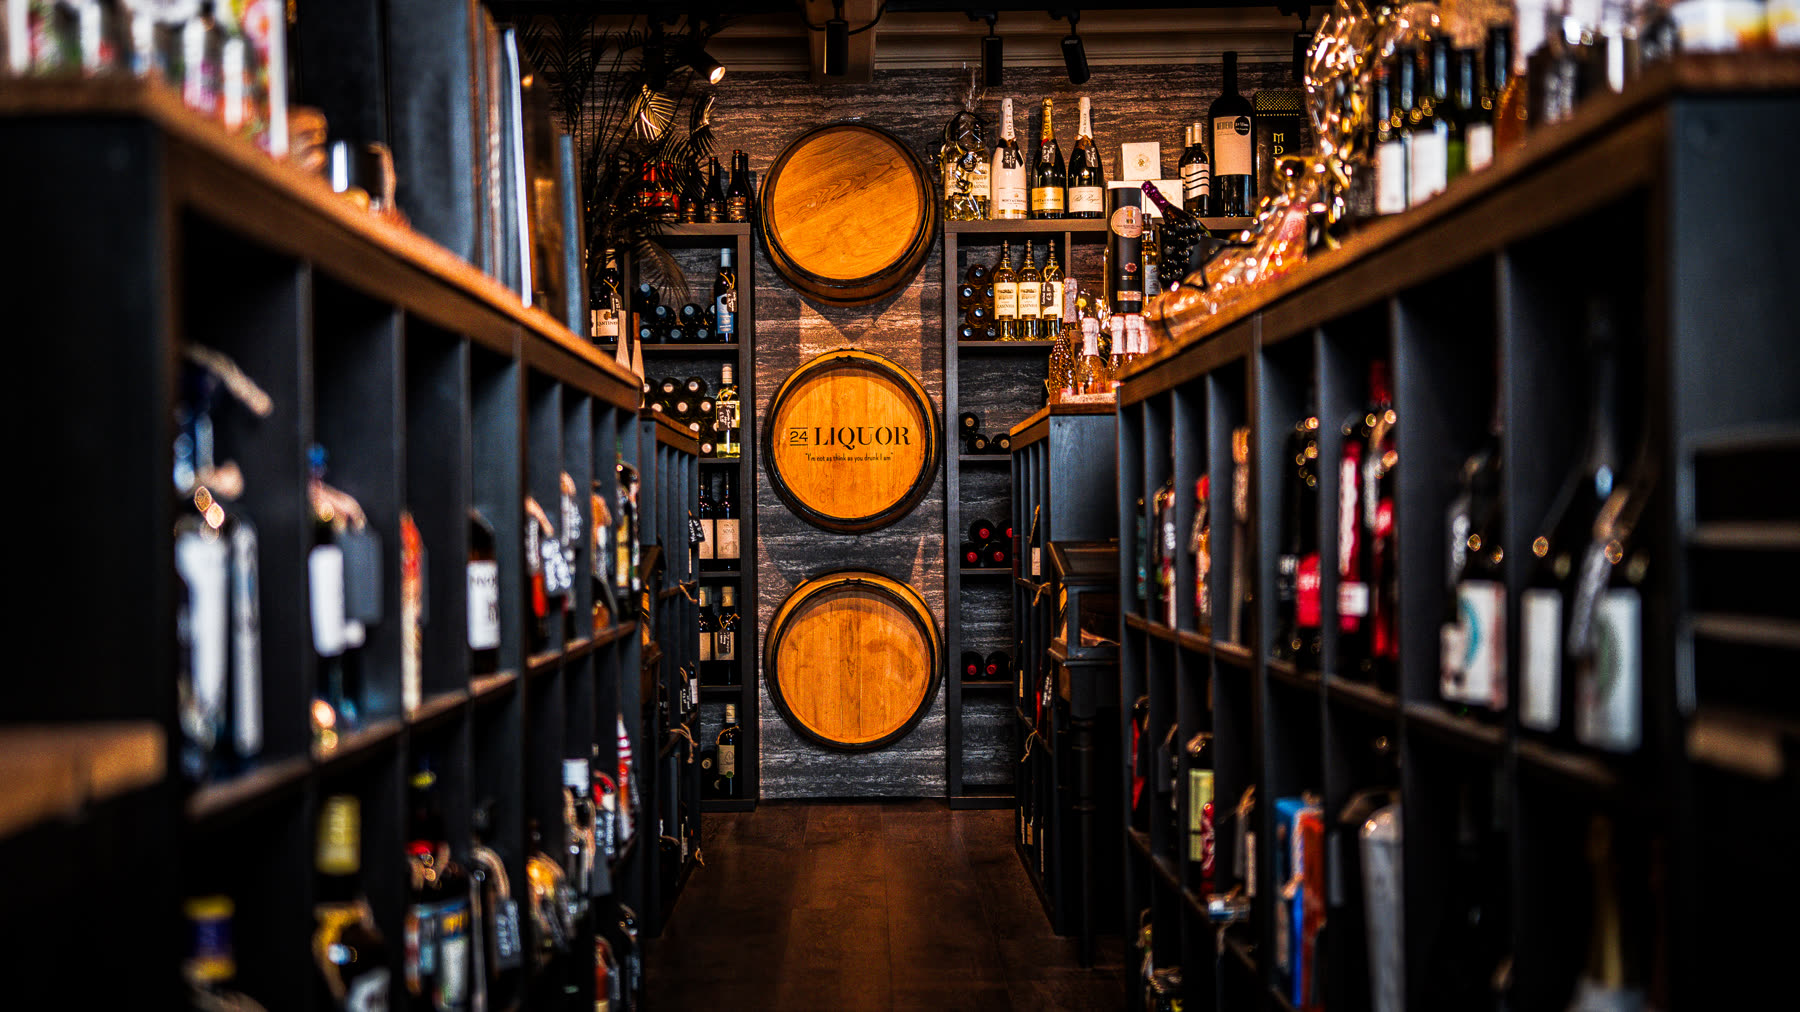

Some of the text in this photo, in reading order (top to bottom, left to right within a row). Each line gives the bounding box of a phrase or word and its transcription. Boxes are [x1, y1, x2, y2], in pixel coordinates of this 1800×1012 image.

[790, 427, 911, 450] 24 LIQUOR
[833, 453, 846, 461] think
[864, 452, 878, 461] drunk
